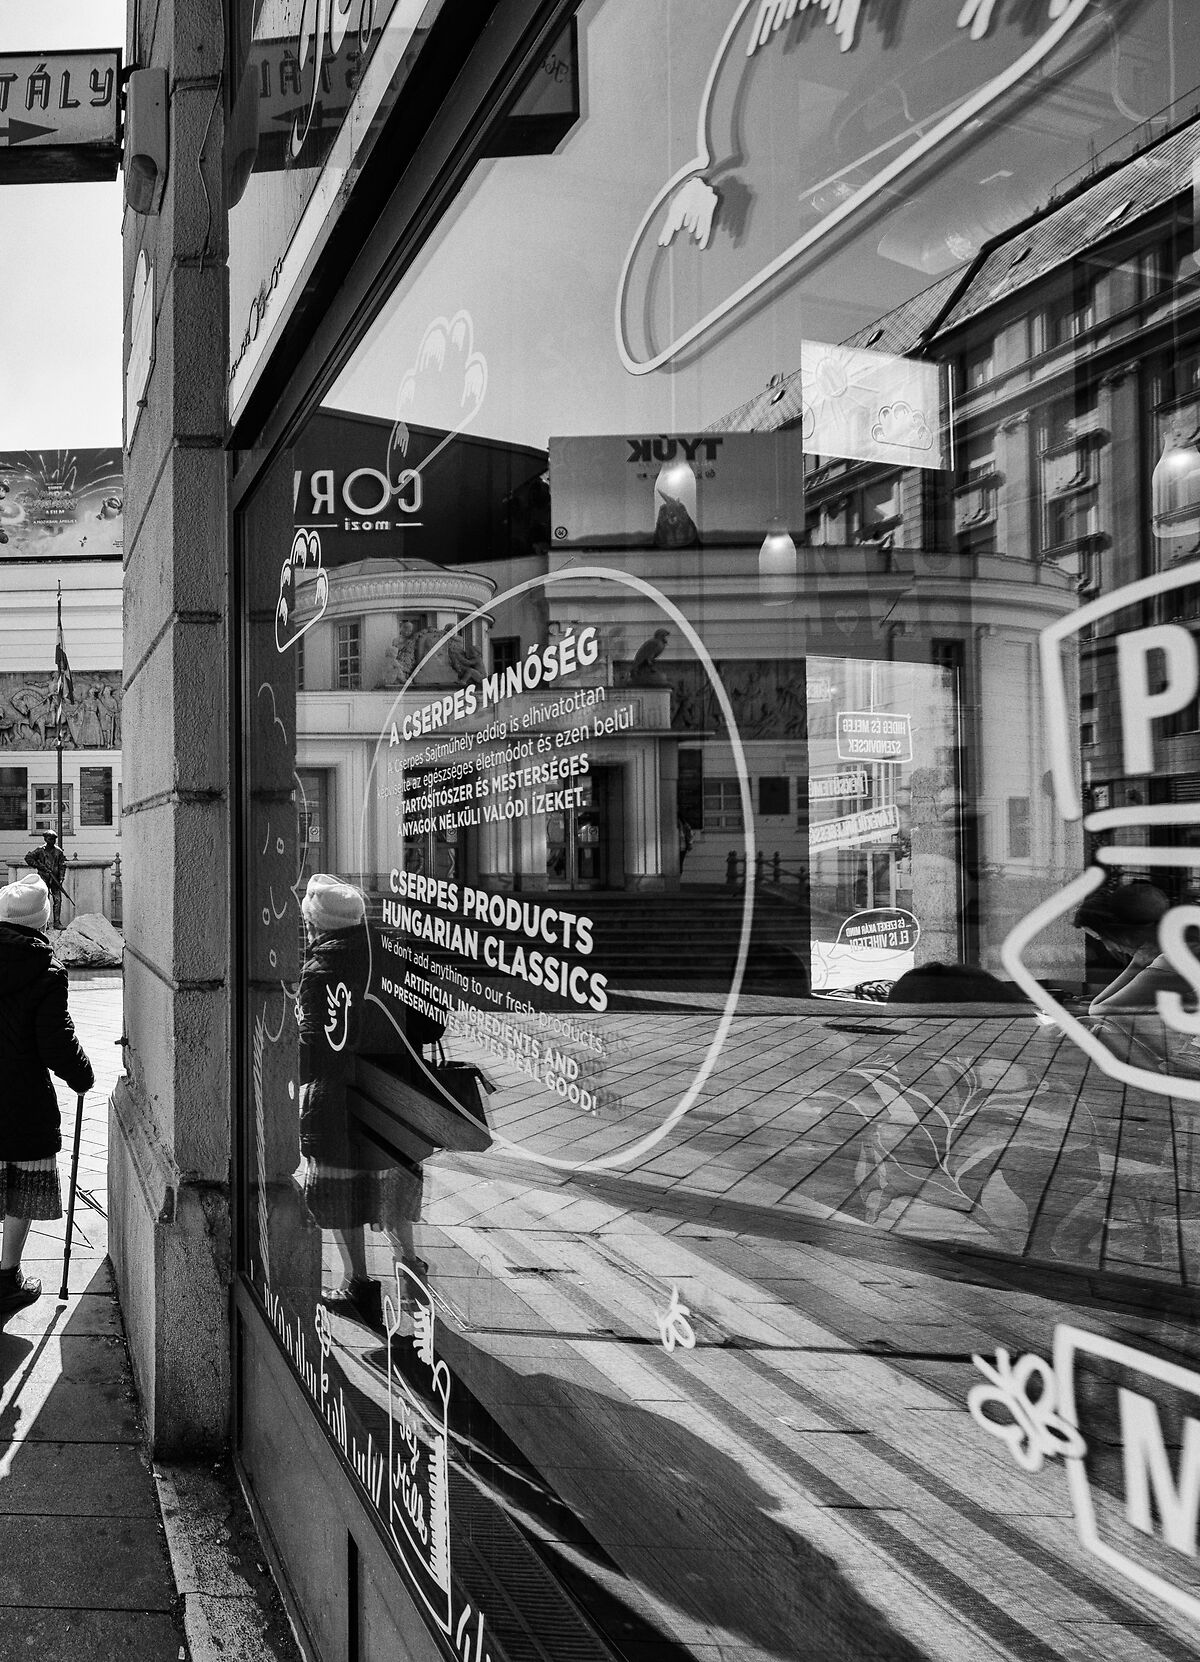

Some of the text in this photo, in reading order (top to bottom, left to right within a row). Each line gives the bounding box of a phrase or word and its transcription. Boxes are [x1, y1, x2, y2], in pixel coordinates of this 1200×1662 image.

[389, 627, 599, 748] A CSERPES MINŐSÉG
[394, 754, 424, 775] Cserpes
[425, 732, 474, 762] Sajtműhely
[476, 721, 507, 745] eddig
[510, 715, 519, 733] is
[522, 685, 605, 728] elhivatottan
[402, 784, 473, 815] TARTÓSÍTÓSZER
[475, 777, 489, 798] ÉS
[492, 753, 589, 793] MESTERSÉGES
[412, 777, 422, 790] az
[423, 761, 474, 788] egészséges
[475, 738, 534, 771] életmódot
[537, 733, 551, 753] és
[555, 724, 589, 748] ezen
[594, 704, 634, 737] belül
[397, 786, 587, 837] ANYAGOK NÉLKÜLI VALÓDI ÍZEKET.
[382, 898, 609, 1012] HUNGARIAN CLASSICS
[389, 868, 594, 955] CSERPES PRODUCTS
[381, 934, 393, 952] We
[393, 941, 413, 959] don't
[413, 953, 429, 970] add
[430, 960, 469, 992] anything
[471, 977, 482, 995] to
[485, 986, 503, 1005] our
[506, 991, 536, 1018] fresh
[381, 976, 392, 994] NO
[506, 1045, 541, 1083] REAL
[545, 1070, 597, 1117] GOOD!
[404, 971, 578, 1081] ARTIFICIAL INGREDIENTS AND
